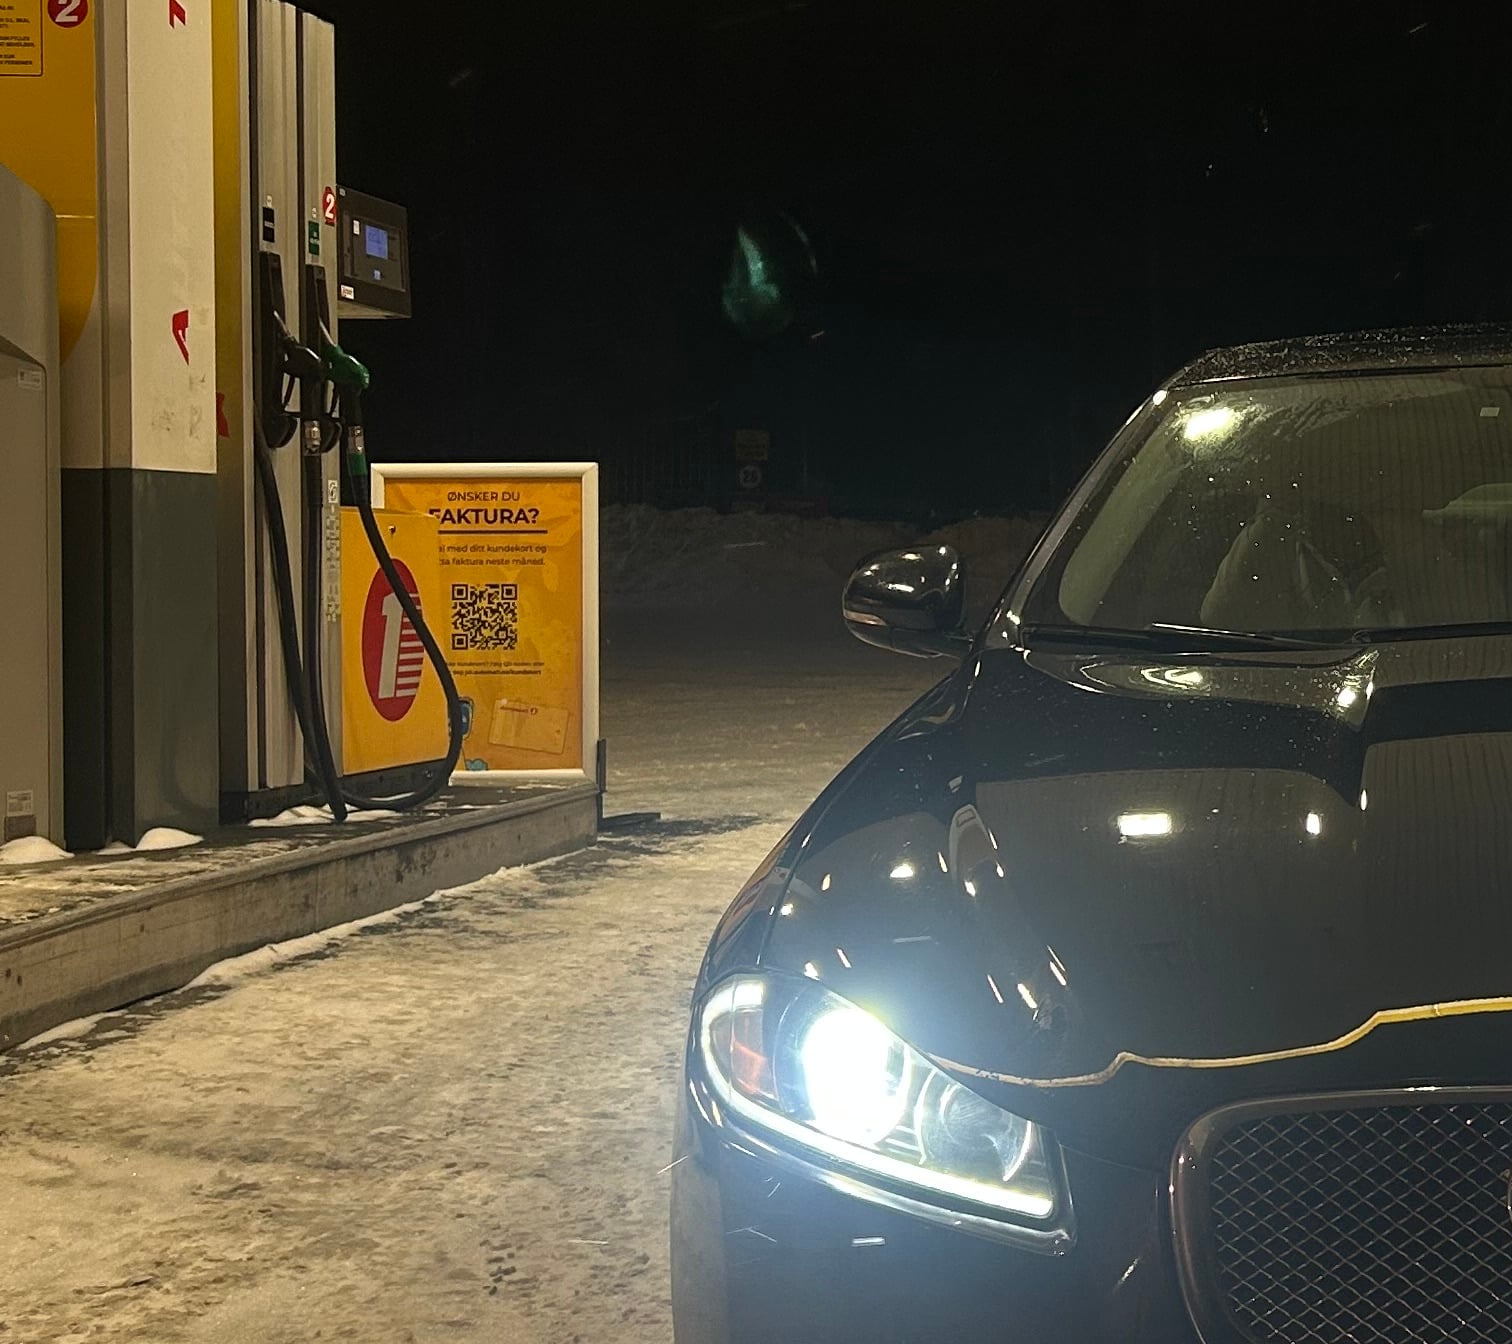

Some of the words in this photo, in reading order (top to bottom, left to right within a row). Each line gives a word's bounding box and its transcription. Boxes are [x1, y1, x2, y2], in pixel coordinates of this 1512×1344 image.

[325, 193, 335, 220] 2
[447, 491, 499, 502] ØNSKER
[501, 491, 521, 502] DU
